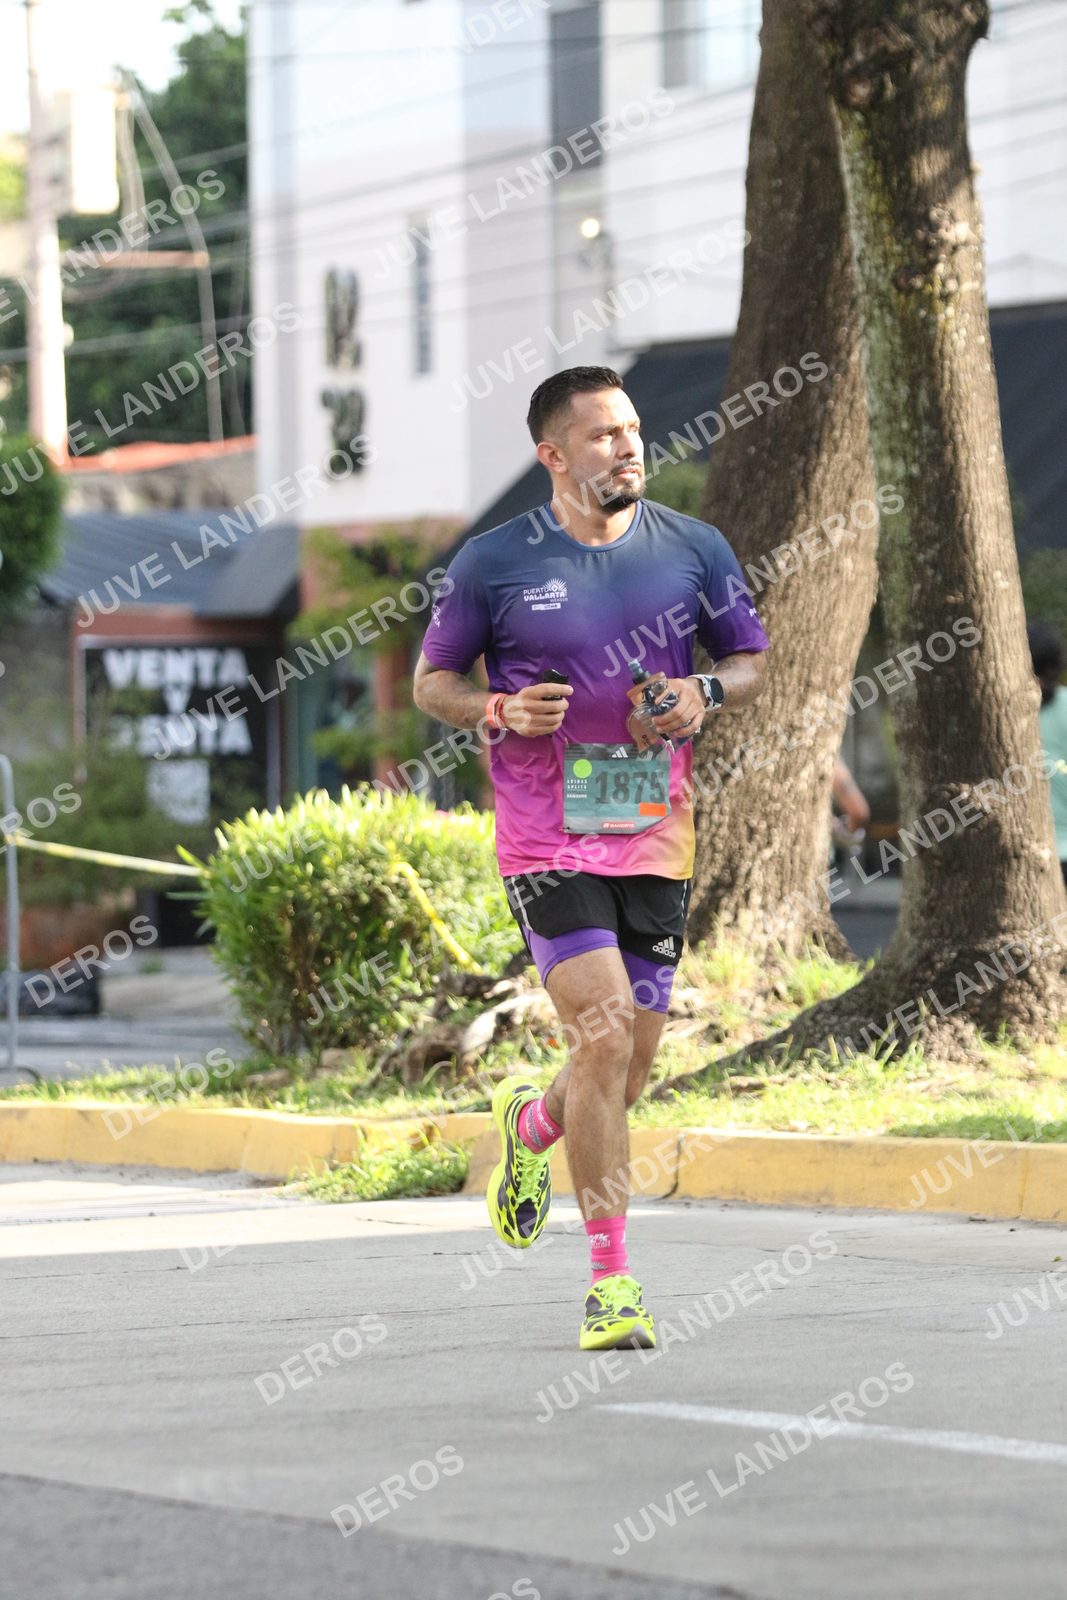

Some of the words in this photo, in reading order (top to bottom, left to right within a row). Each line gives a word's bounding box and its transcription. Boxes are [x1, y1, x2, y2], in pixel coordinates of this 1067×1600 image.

[523, 591, 565, 602] VALLARTA
[103, 648, 250, 689] VENTA
[595, 770, 666, 804] 1875
[652, 945, 676, 958] adidas
